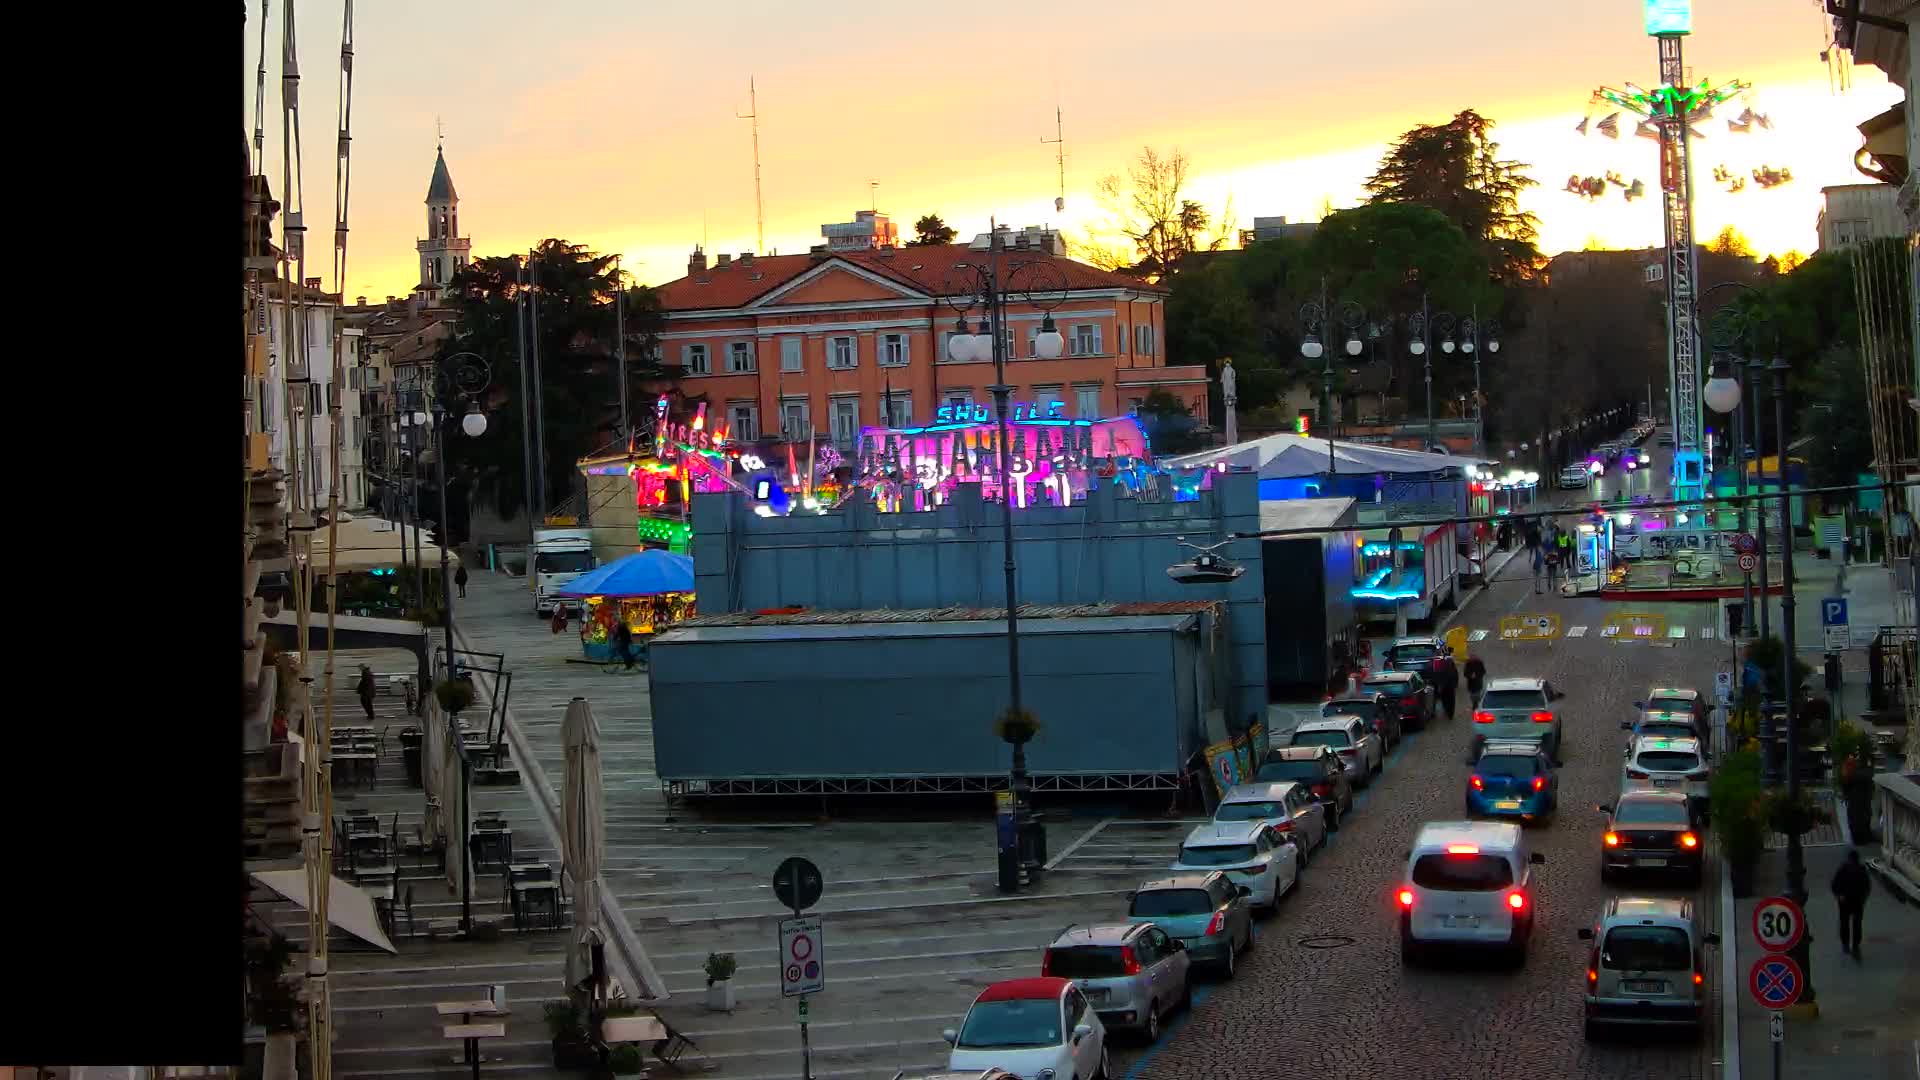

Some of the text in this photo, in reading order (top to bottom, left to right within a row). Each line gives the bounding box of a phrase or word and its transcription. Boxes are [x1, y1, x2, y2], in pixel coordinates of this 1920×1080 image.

[1742, 557, 1752, 567] 20
[1826, 602, 1842, 622] P
[1761, 911, 1792, 938] 30
